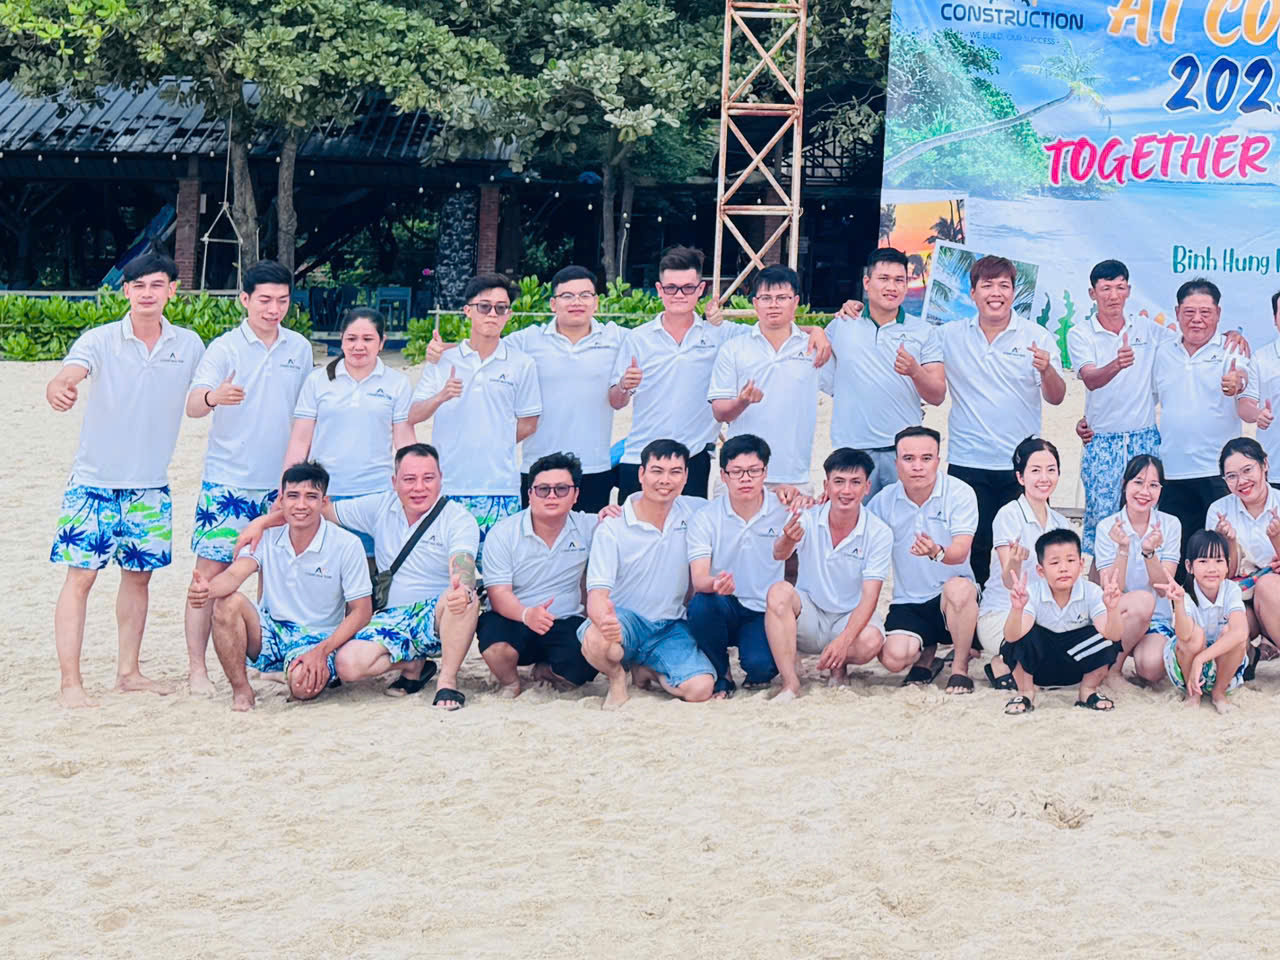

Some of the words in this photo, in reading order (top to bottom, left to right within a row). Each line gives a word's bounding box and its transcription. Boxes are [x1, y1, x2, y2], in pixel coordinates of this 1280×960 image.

[941, 3, 1084, 30] CONSTRUCTION
[1043, 130, 1270, 185] TOGETHER
[1172, 245, 1217, 274] Binh
[1223, 248, 1270, 275] Hung
